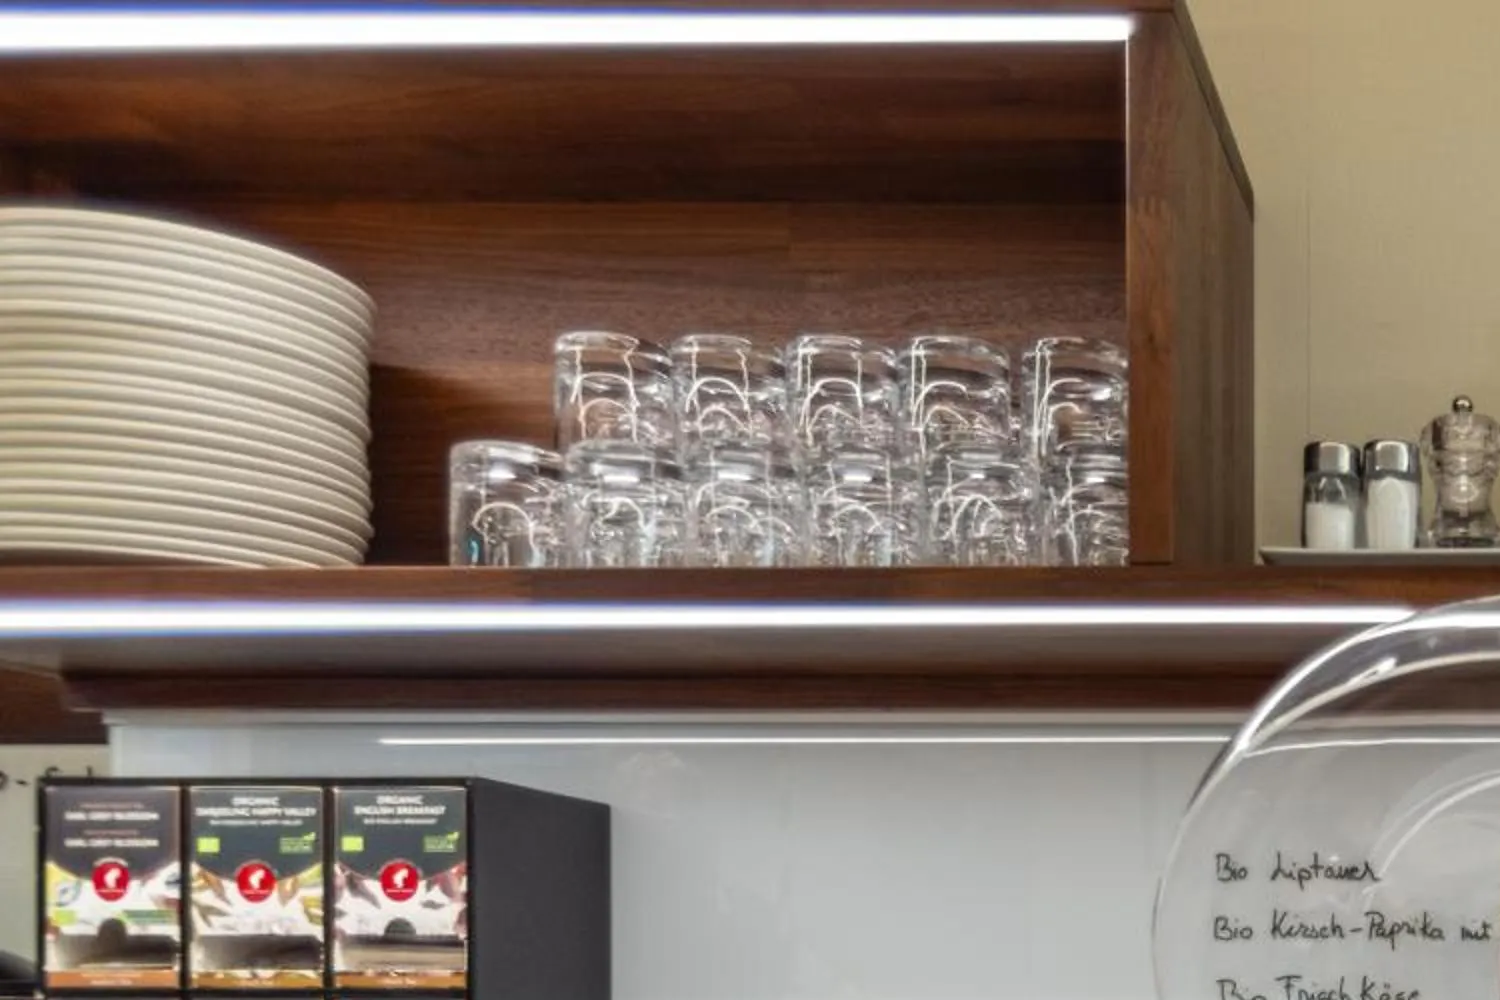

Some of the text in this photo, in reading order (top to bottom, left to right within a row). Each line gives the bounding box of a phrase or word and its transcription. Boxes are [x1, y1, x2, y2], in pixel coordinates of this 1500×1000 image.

[1216, 851, 1381, 890] Bio Liptauer
[1213, 915, 1254, 941] Bio
